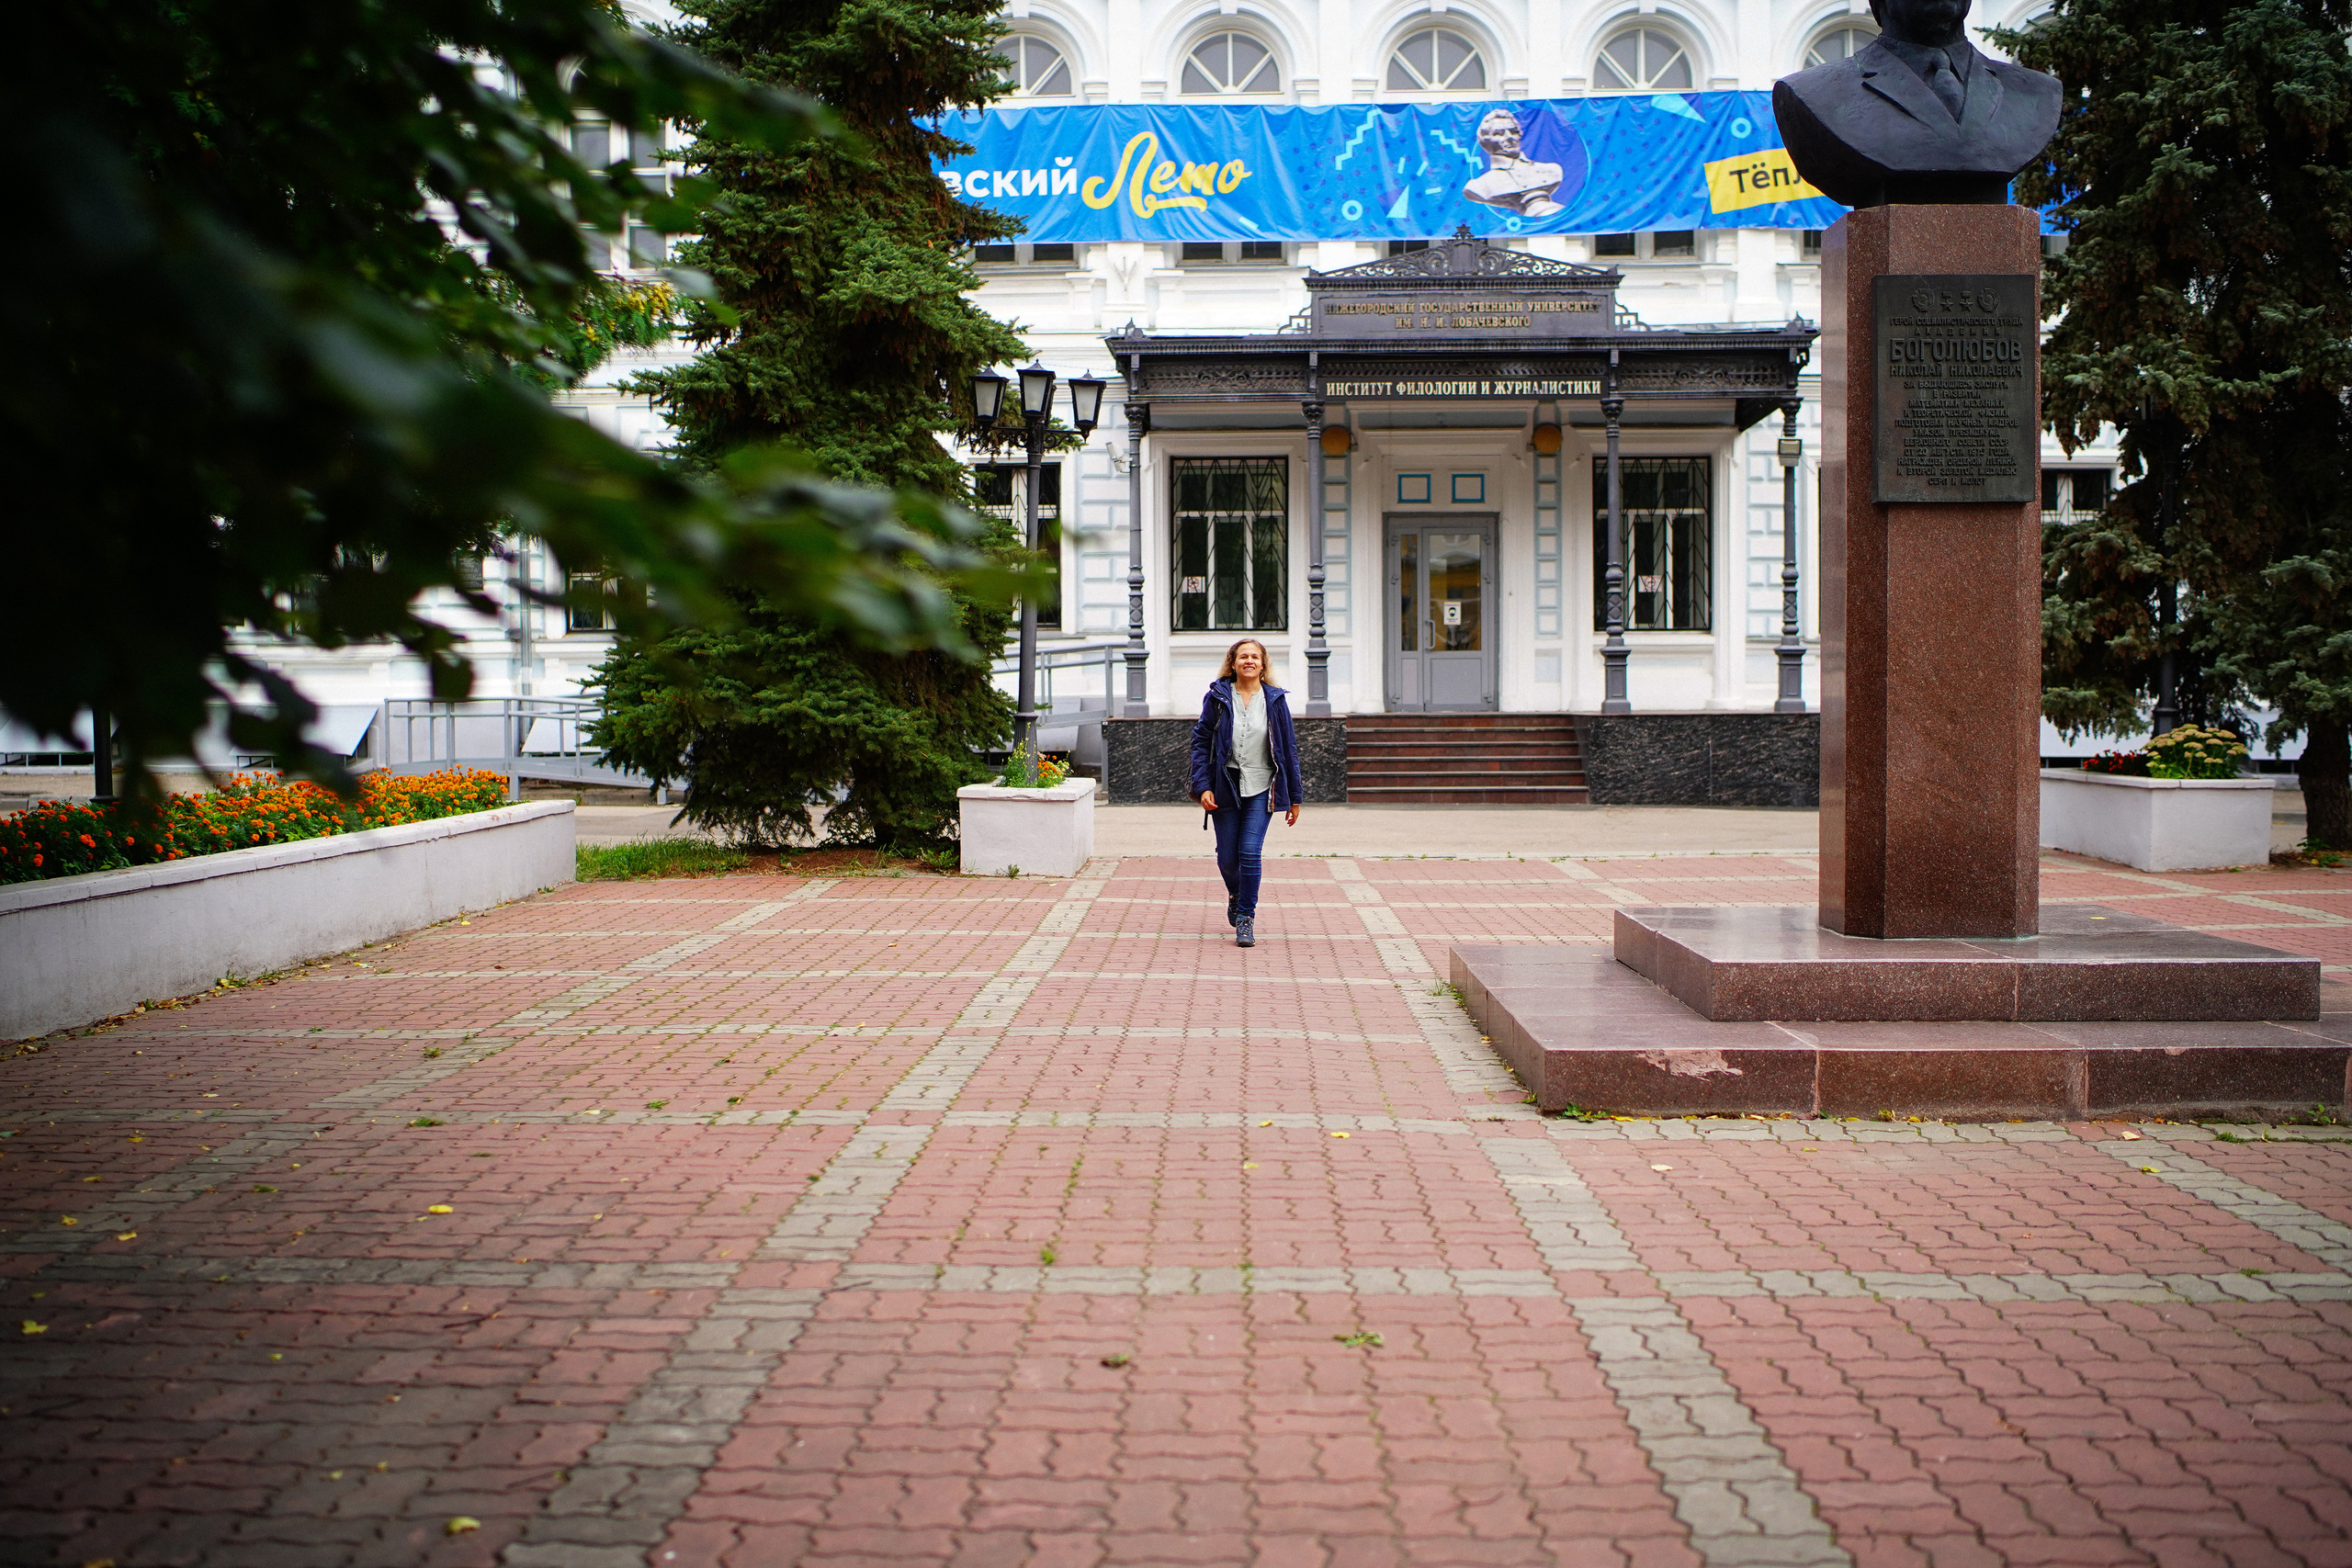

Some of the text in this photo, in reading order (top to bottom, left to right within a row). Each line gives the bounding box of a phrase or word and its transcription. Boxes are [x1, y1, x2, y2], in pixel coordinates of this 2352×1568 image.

[1081, 131, 1251, 219] Лето
[1324, 299, 1600, 315] НИЖЕГОРОДСКИЙ ГОСУДАРСТВЕННЫЙ УНИВЕРСИТЕТ
[1395, 316, 1531, 329] ИМ. Н. И. ЛОБАЧЕВСКОГО
[1890, 316, 1914, 326] ГЕРОЙ
[1917, 317, 1996, 326] СОЦИАЛИСТИЧЕСКОГО
[1890, 338, 2023, 362] БОГОЛЮБОВ
[1890, 363, 2023, 378] НИКОЛАЙ НИКОЛАЕВИЧ
[1326, 380, 1601, 396] ИНСТИТУТ ФИЛОЛОГИИ И ЖУРНАЛИСТИКИ
[1904, 380, 1915, 389] ЗА
[1933, 389, 1939, 399] В
[1988, 418, 2019, 427] КАДРОВ
[1904, 437, 2009, 446] ВЕРХОВНОГО СОВЕТА СССР
[1930, 447, 1965, 457] АВГУСТА
